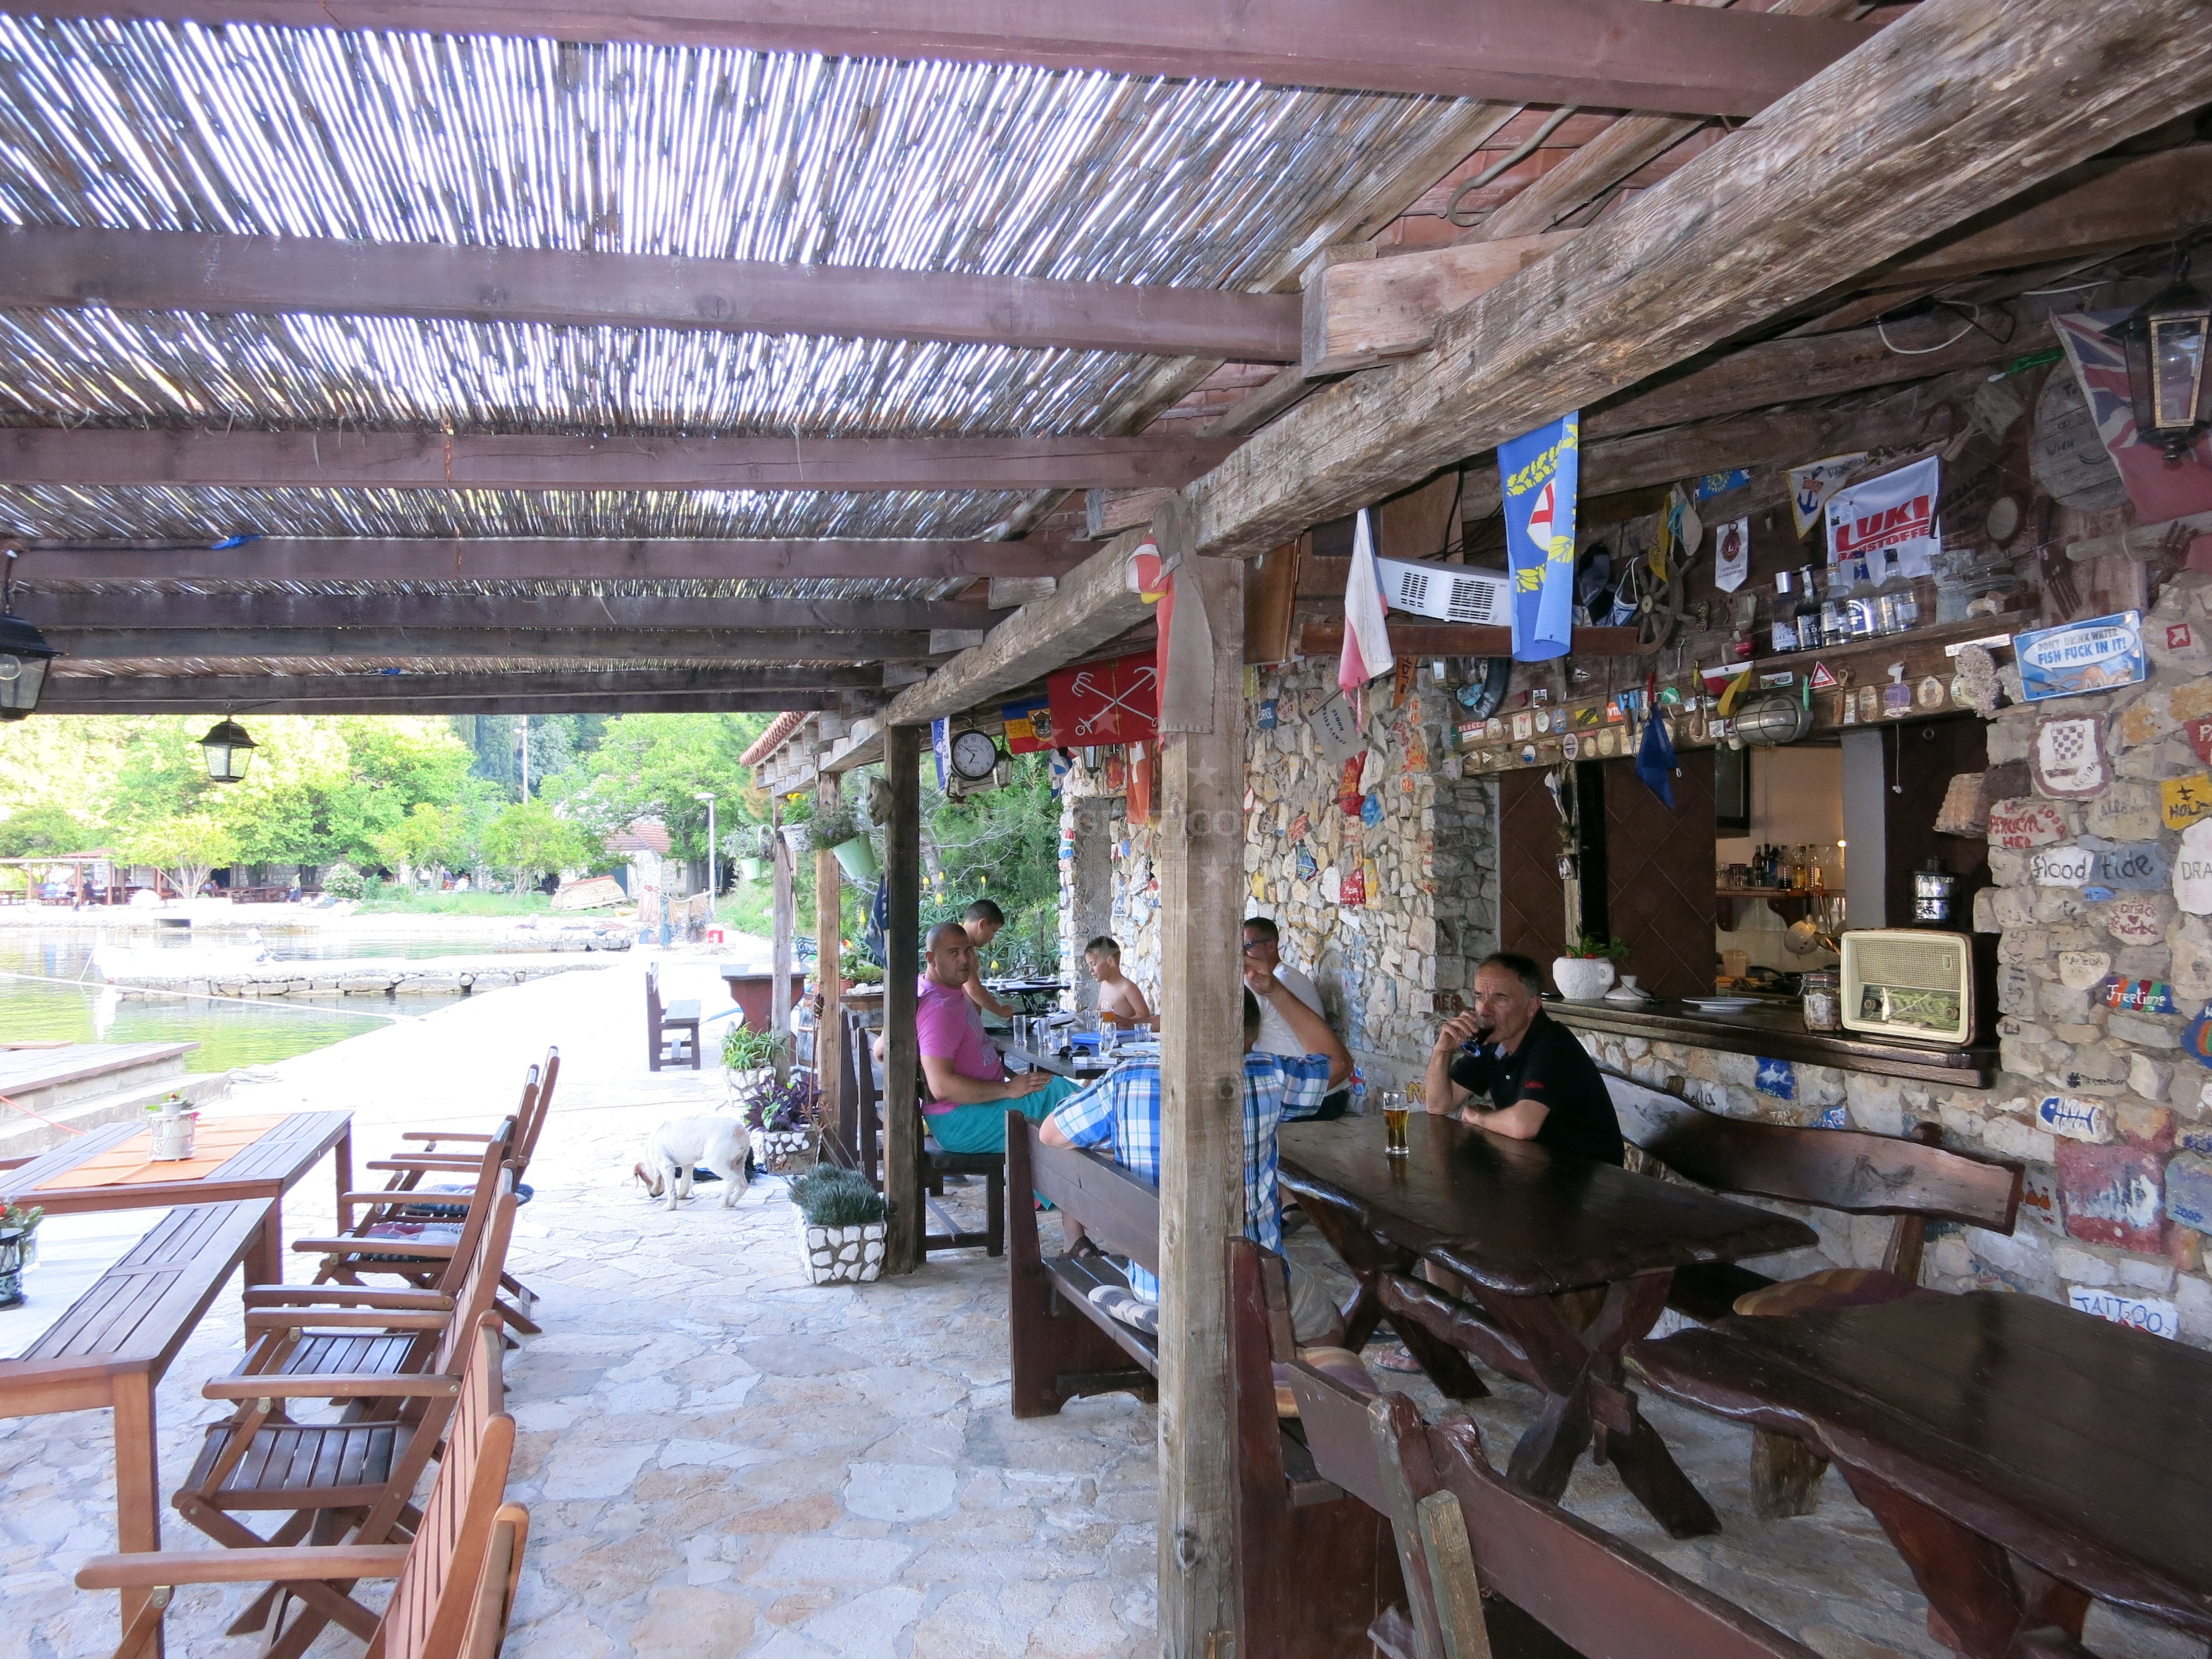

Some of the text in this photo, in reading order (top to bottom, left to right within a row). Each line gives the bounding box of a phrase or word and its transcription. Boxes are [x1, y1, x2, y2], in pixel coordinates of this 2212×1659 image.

[1836, 495, 1929, 552] LUKI
[2038, 637, 2127, 665] FISH FUCK IN IT!
[2064, 632, 2090, 646] DRINK
[2091, 628, 2119, 640] WATER
[2031, 850, 2087, 880] flood
[2101, 852, 2153, 879] tide
[2106, 983, 2166, 1007] Freetime
[2073, 1296, 2162, 1333] TATTOO
